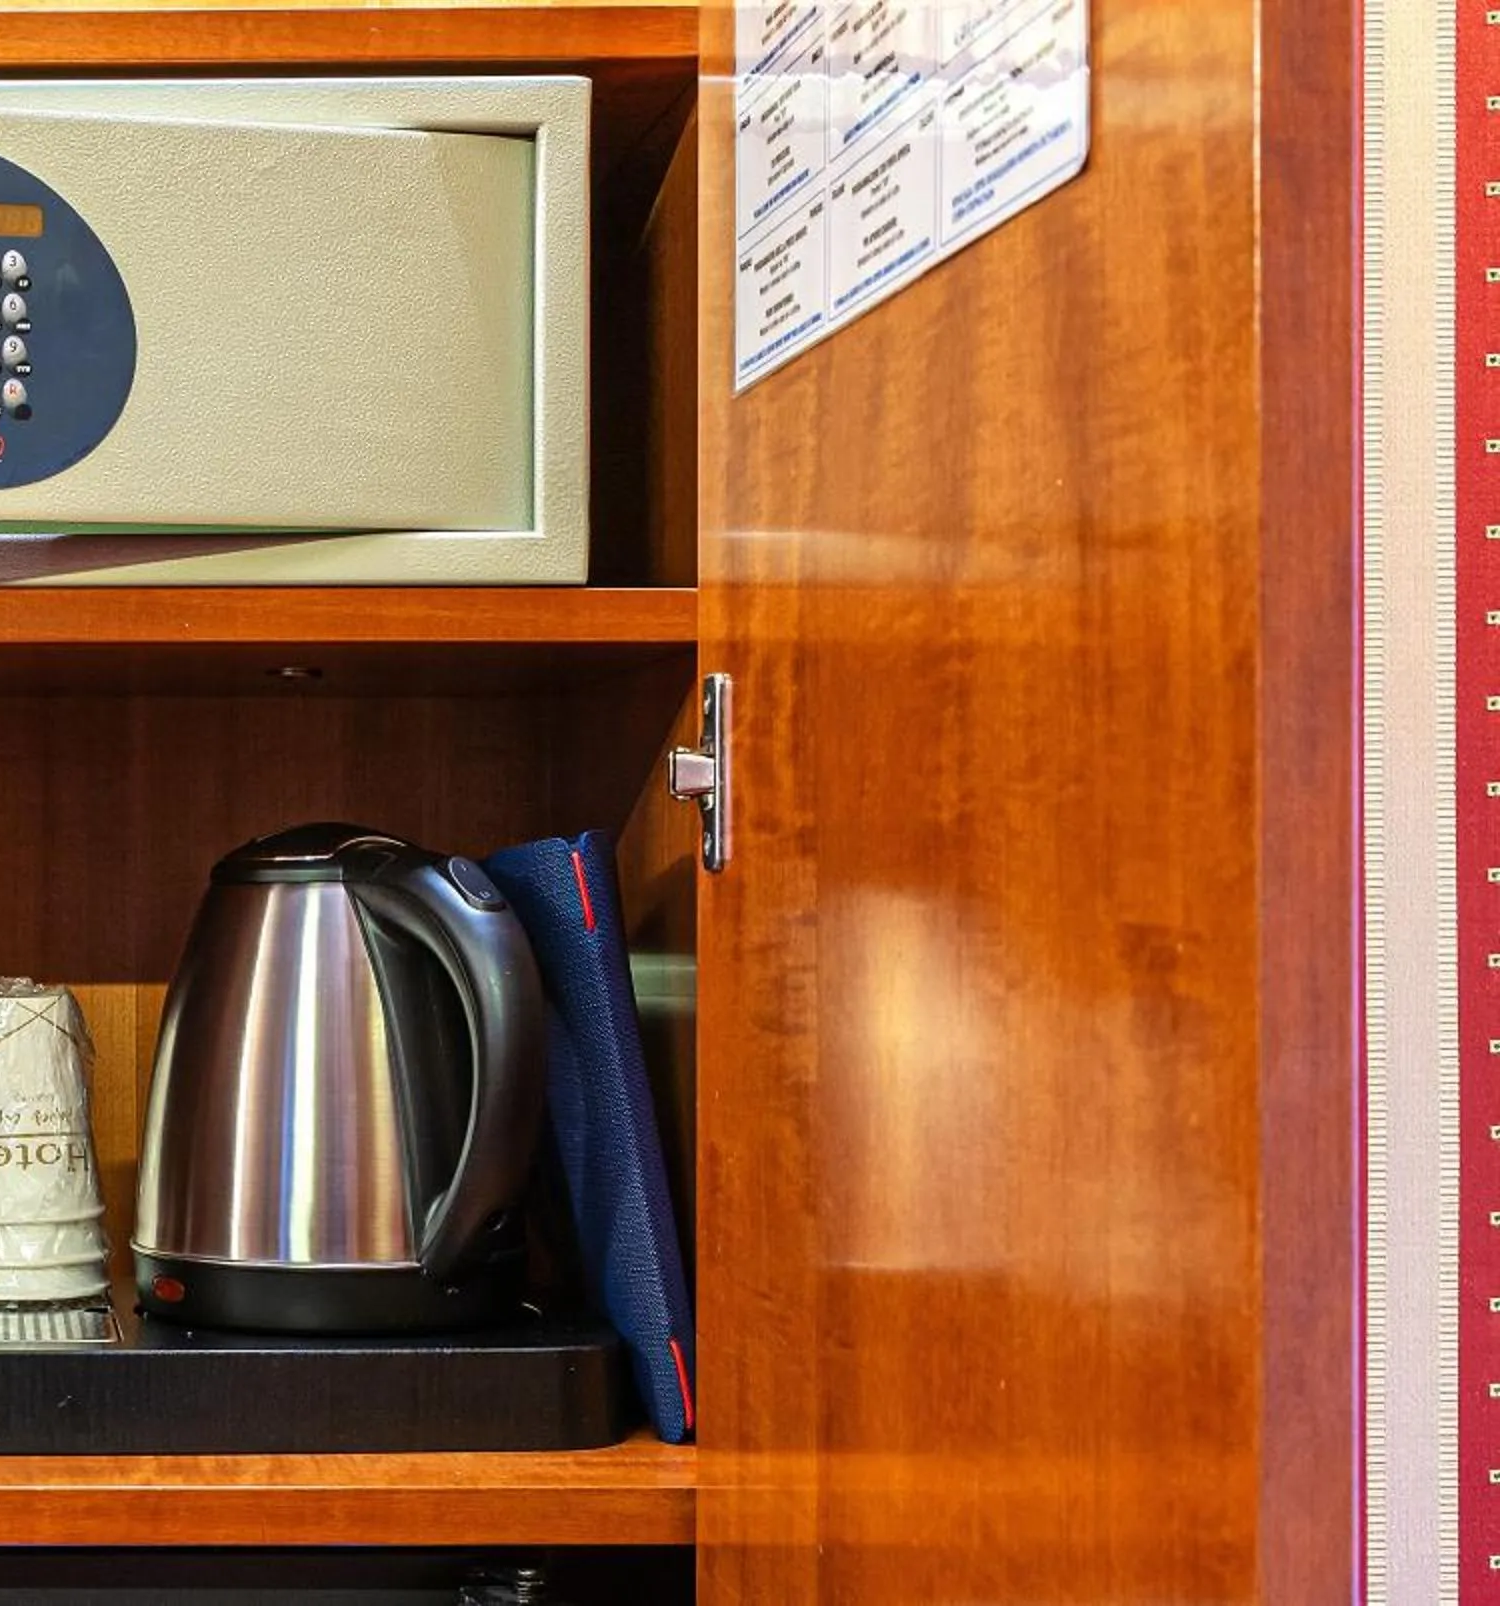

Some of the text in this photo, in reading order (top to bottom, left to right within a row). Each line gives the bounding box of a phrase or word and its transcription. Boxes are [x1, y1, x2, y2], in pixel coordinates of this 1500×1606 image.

[9, 256, 17, 267] 3
[9, 300, 17, 311] 6
[9, 341, 17, 353] 9
[9, 384, 17, 395] R
